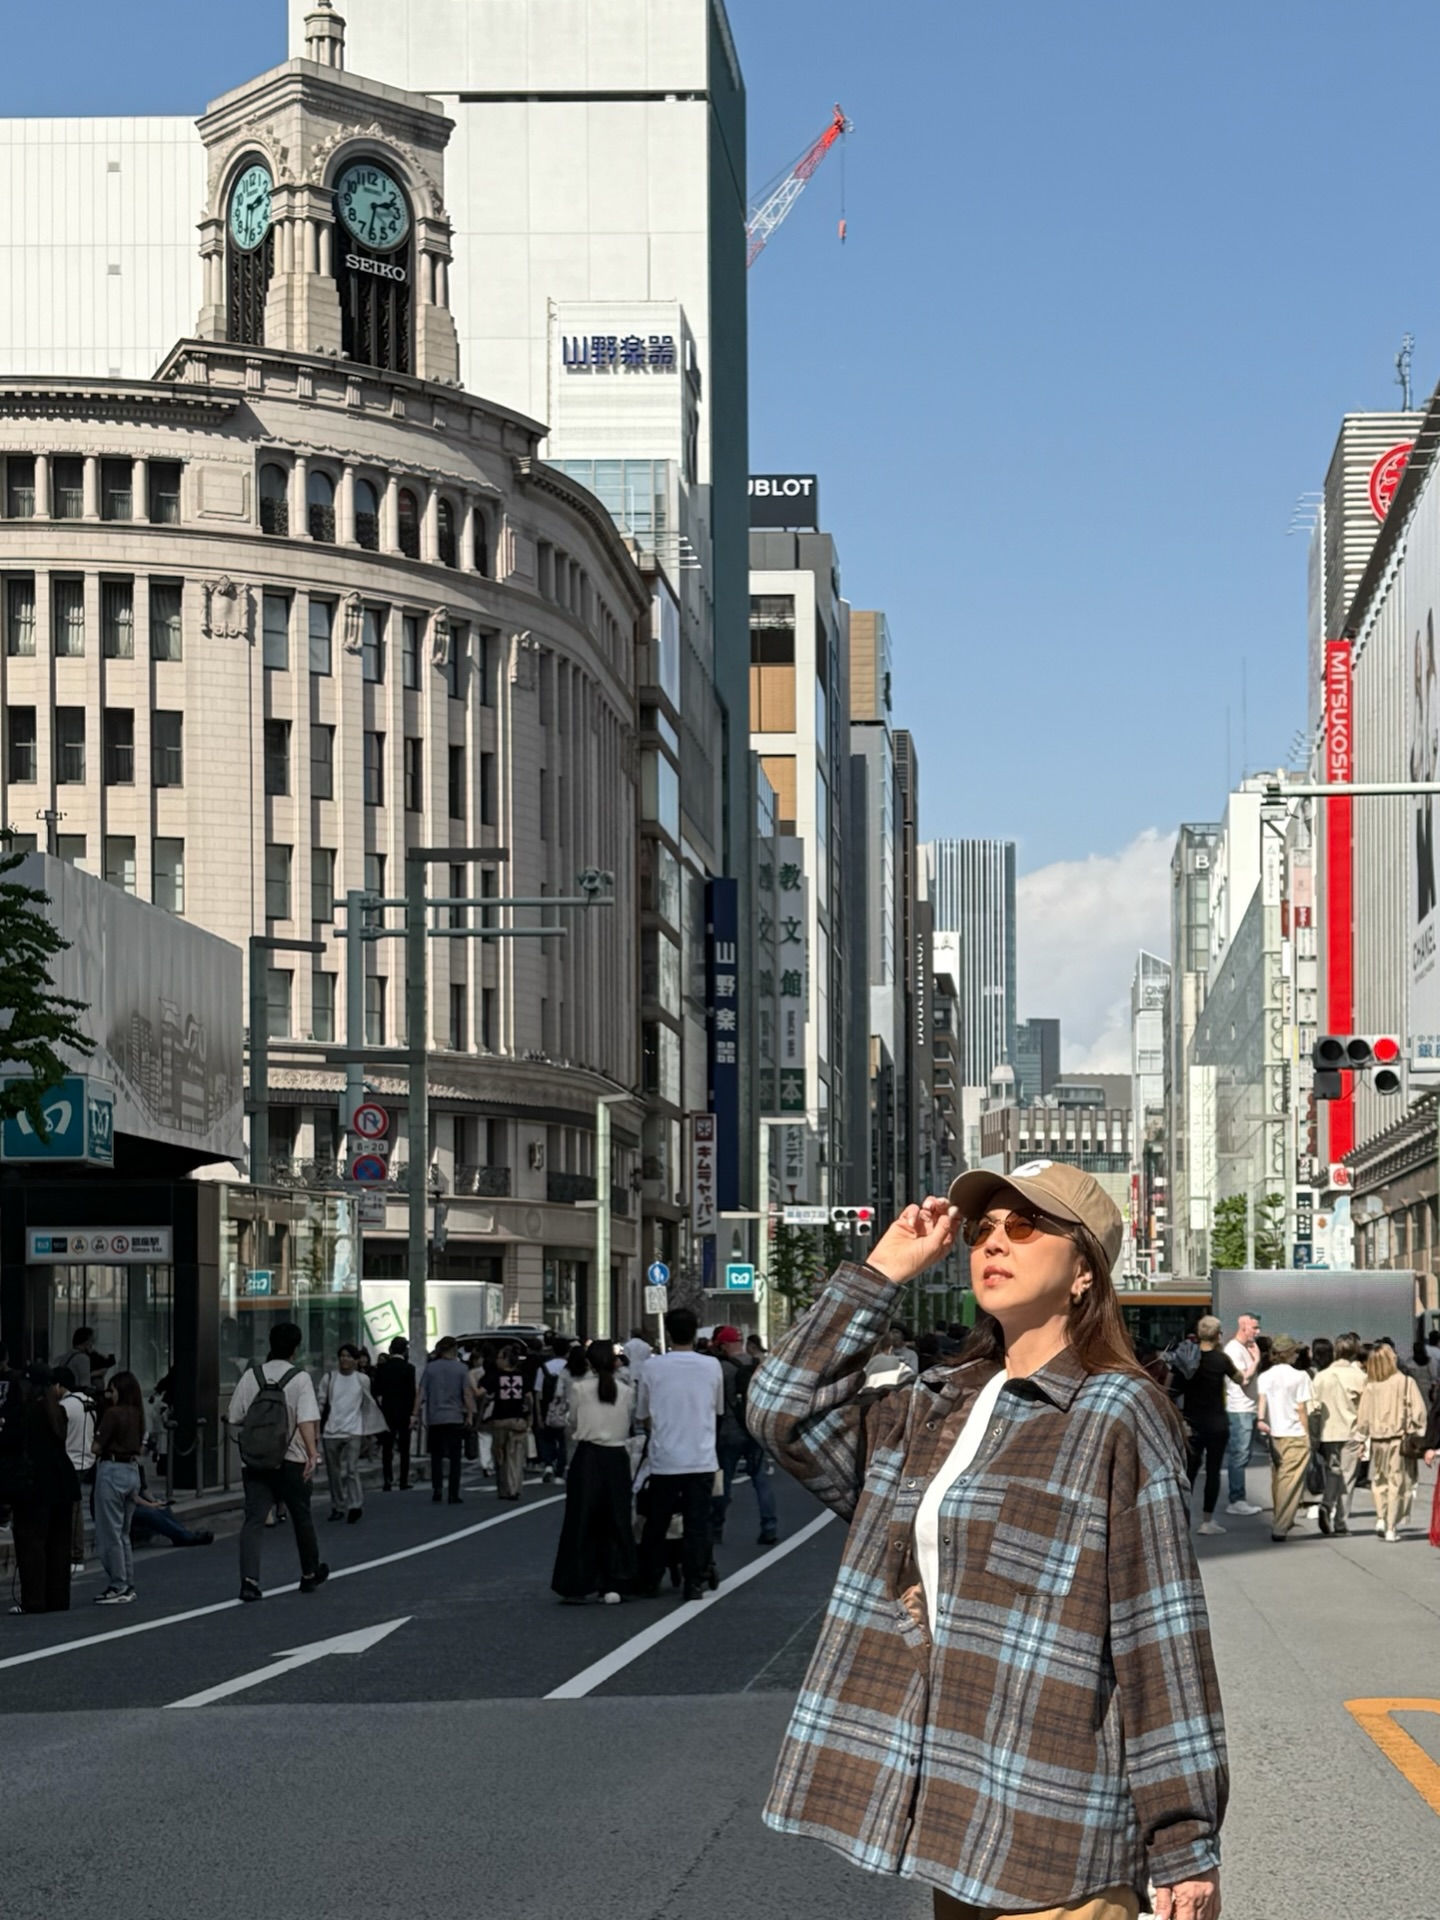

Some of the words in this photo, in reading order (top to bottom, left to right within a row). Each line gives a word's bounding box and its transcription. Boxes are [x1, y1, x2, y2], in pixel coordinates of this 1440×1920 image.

[367, 172, 378, 186] 12
[382, 180, 386, 192] 1
[346, 180, 357, 194] 10
[344, 193, 352, 206] 9
[348, 208, 356, 221] 8
[358, 220, 366, 233] 7
[380, 227, 388, 240] 5
[388, 220, 397, 233] 4
[345, 254, 406, 281] SEIKO
[563, 335, 674, 366] 山野楽器
[1331, 651, 1348, 784] MITSUKOSH
[779, 862, 802, 997] 教文館
[716, 942, 736, 1064] 山野楽器
[782, 1075, 802, 1104] 本
[697, 1146, 713, 1228] キムラヤのパン
